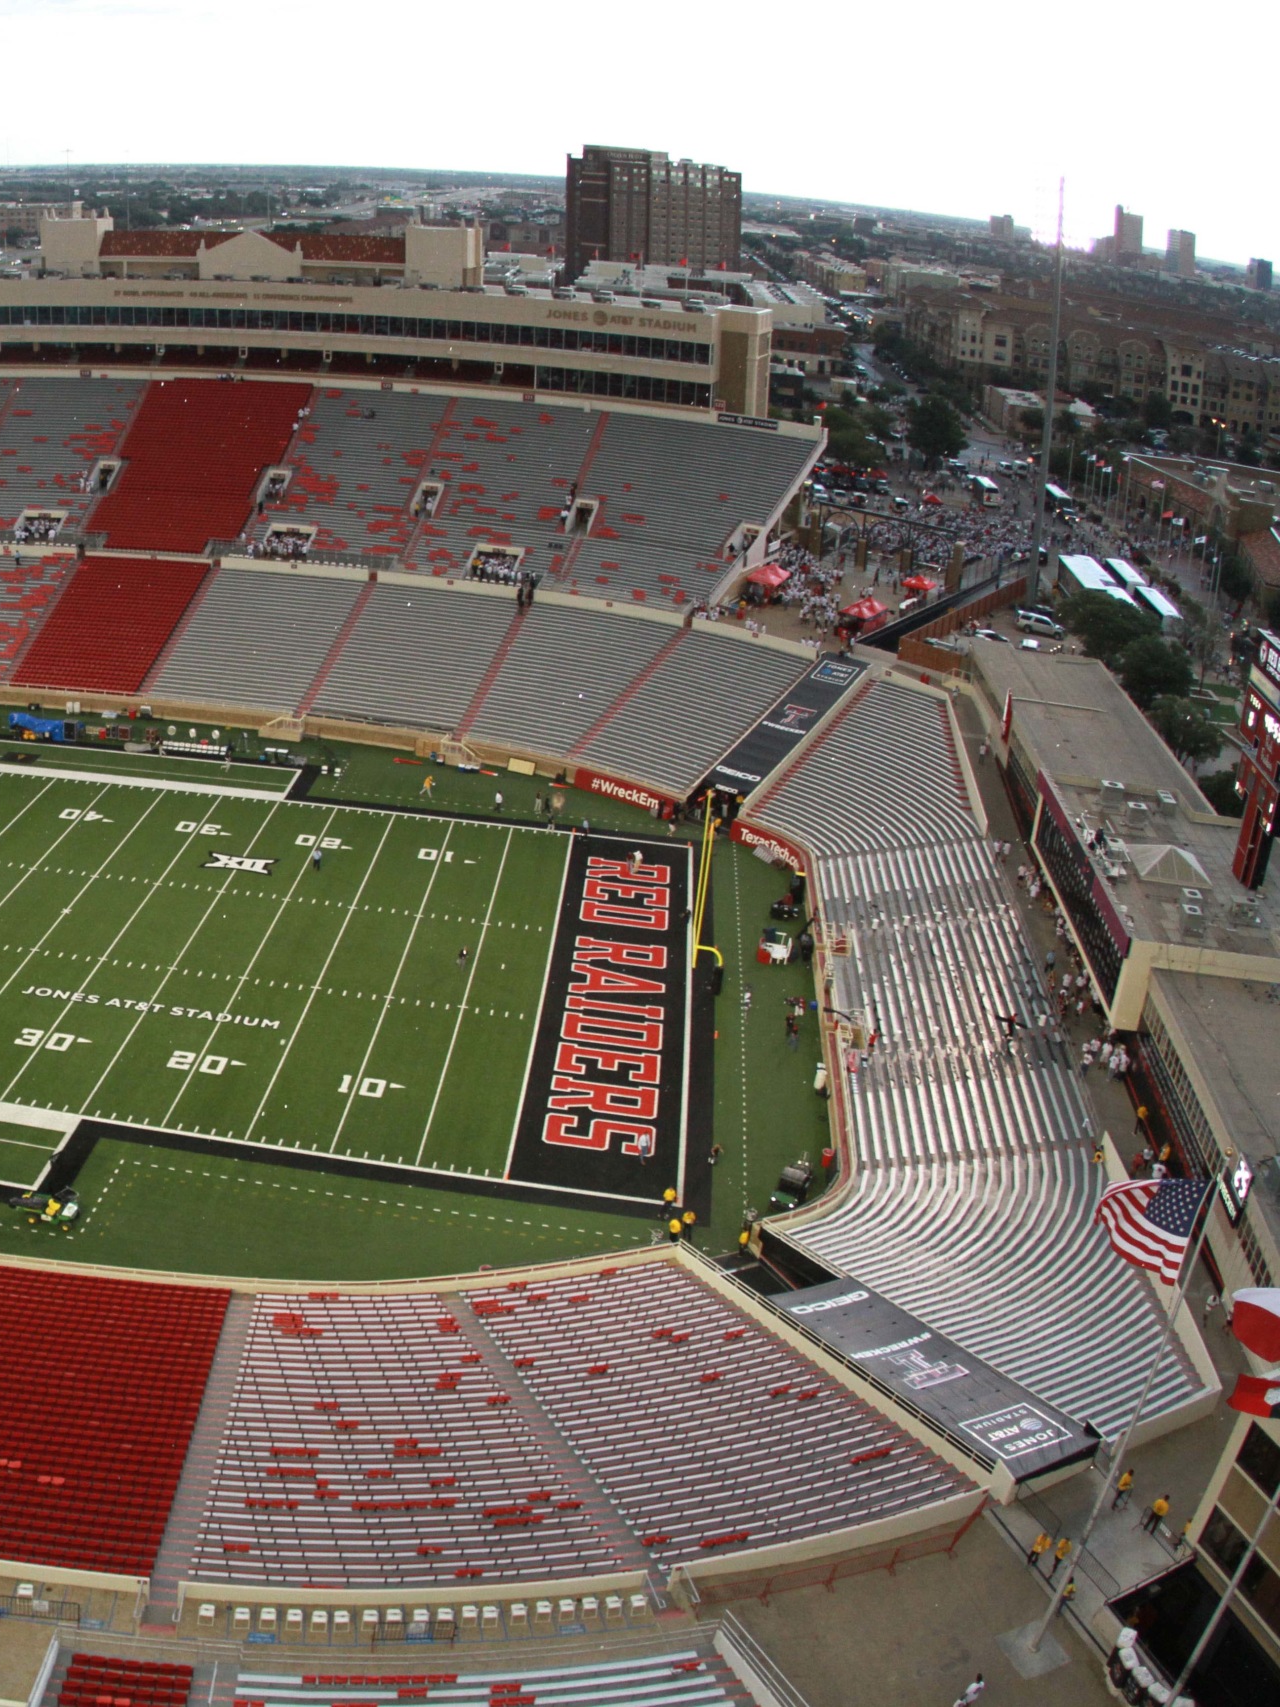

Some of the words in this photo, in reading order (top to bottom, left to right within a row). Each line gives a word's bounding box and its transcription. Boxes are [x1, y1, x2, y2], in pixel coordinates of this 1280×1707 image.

[546, 309, 588, 321] JONES
[639, 318, 696, 333] STADIUM
[827, 664, 853, 673] JONES
[715, 764, 761, 783] GEICO
[591, 778, 660, 811] #WreckEm
[715, 784, 738, 795] GEICO
[579, 856, 670, 931] RED
[21, 985, 100, 1004] JONES
[105, 997, 161, 1014] AT&T
[170, 1005, 281, 1030] STADIUM
[14, 1028, 75, 1052] 30
[542, 935, 668, 1157] RAIDERS
[167, 1050, 229, 1075] 20
[338, 1074, 387, 1098] 10
[790, 1290, 870, 1315] GEICO
[972, 1409, 1028, 1431] STADIUM
[988, 1425, 1020, 1442] AT&T
[1003, 1429, 1055, 1452] JONES
